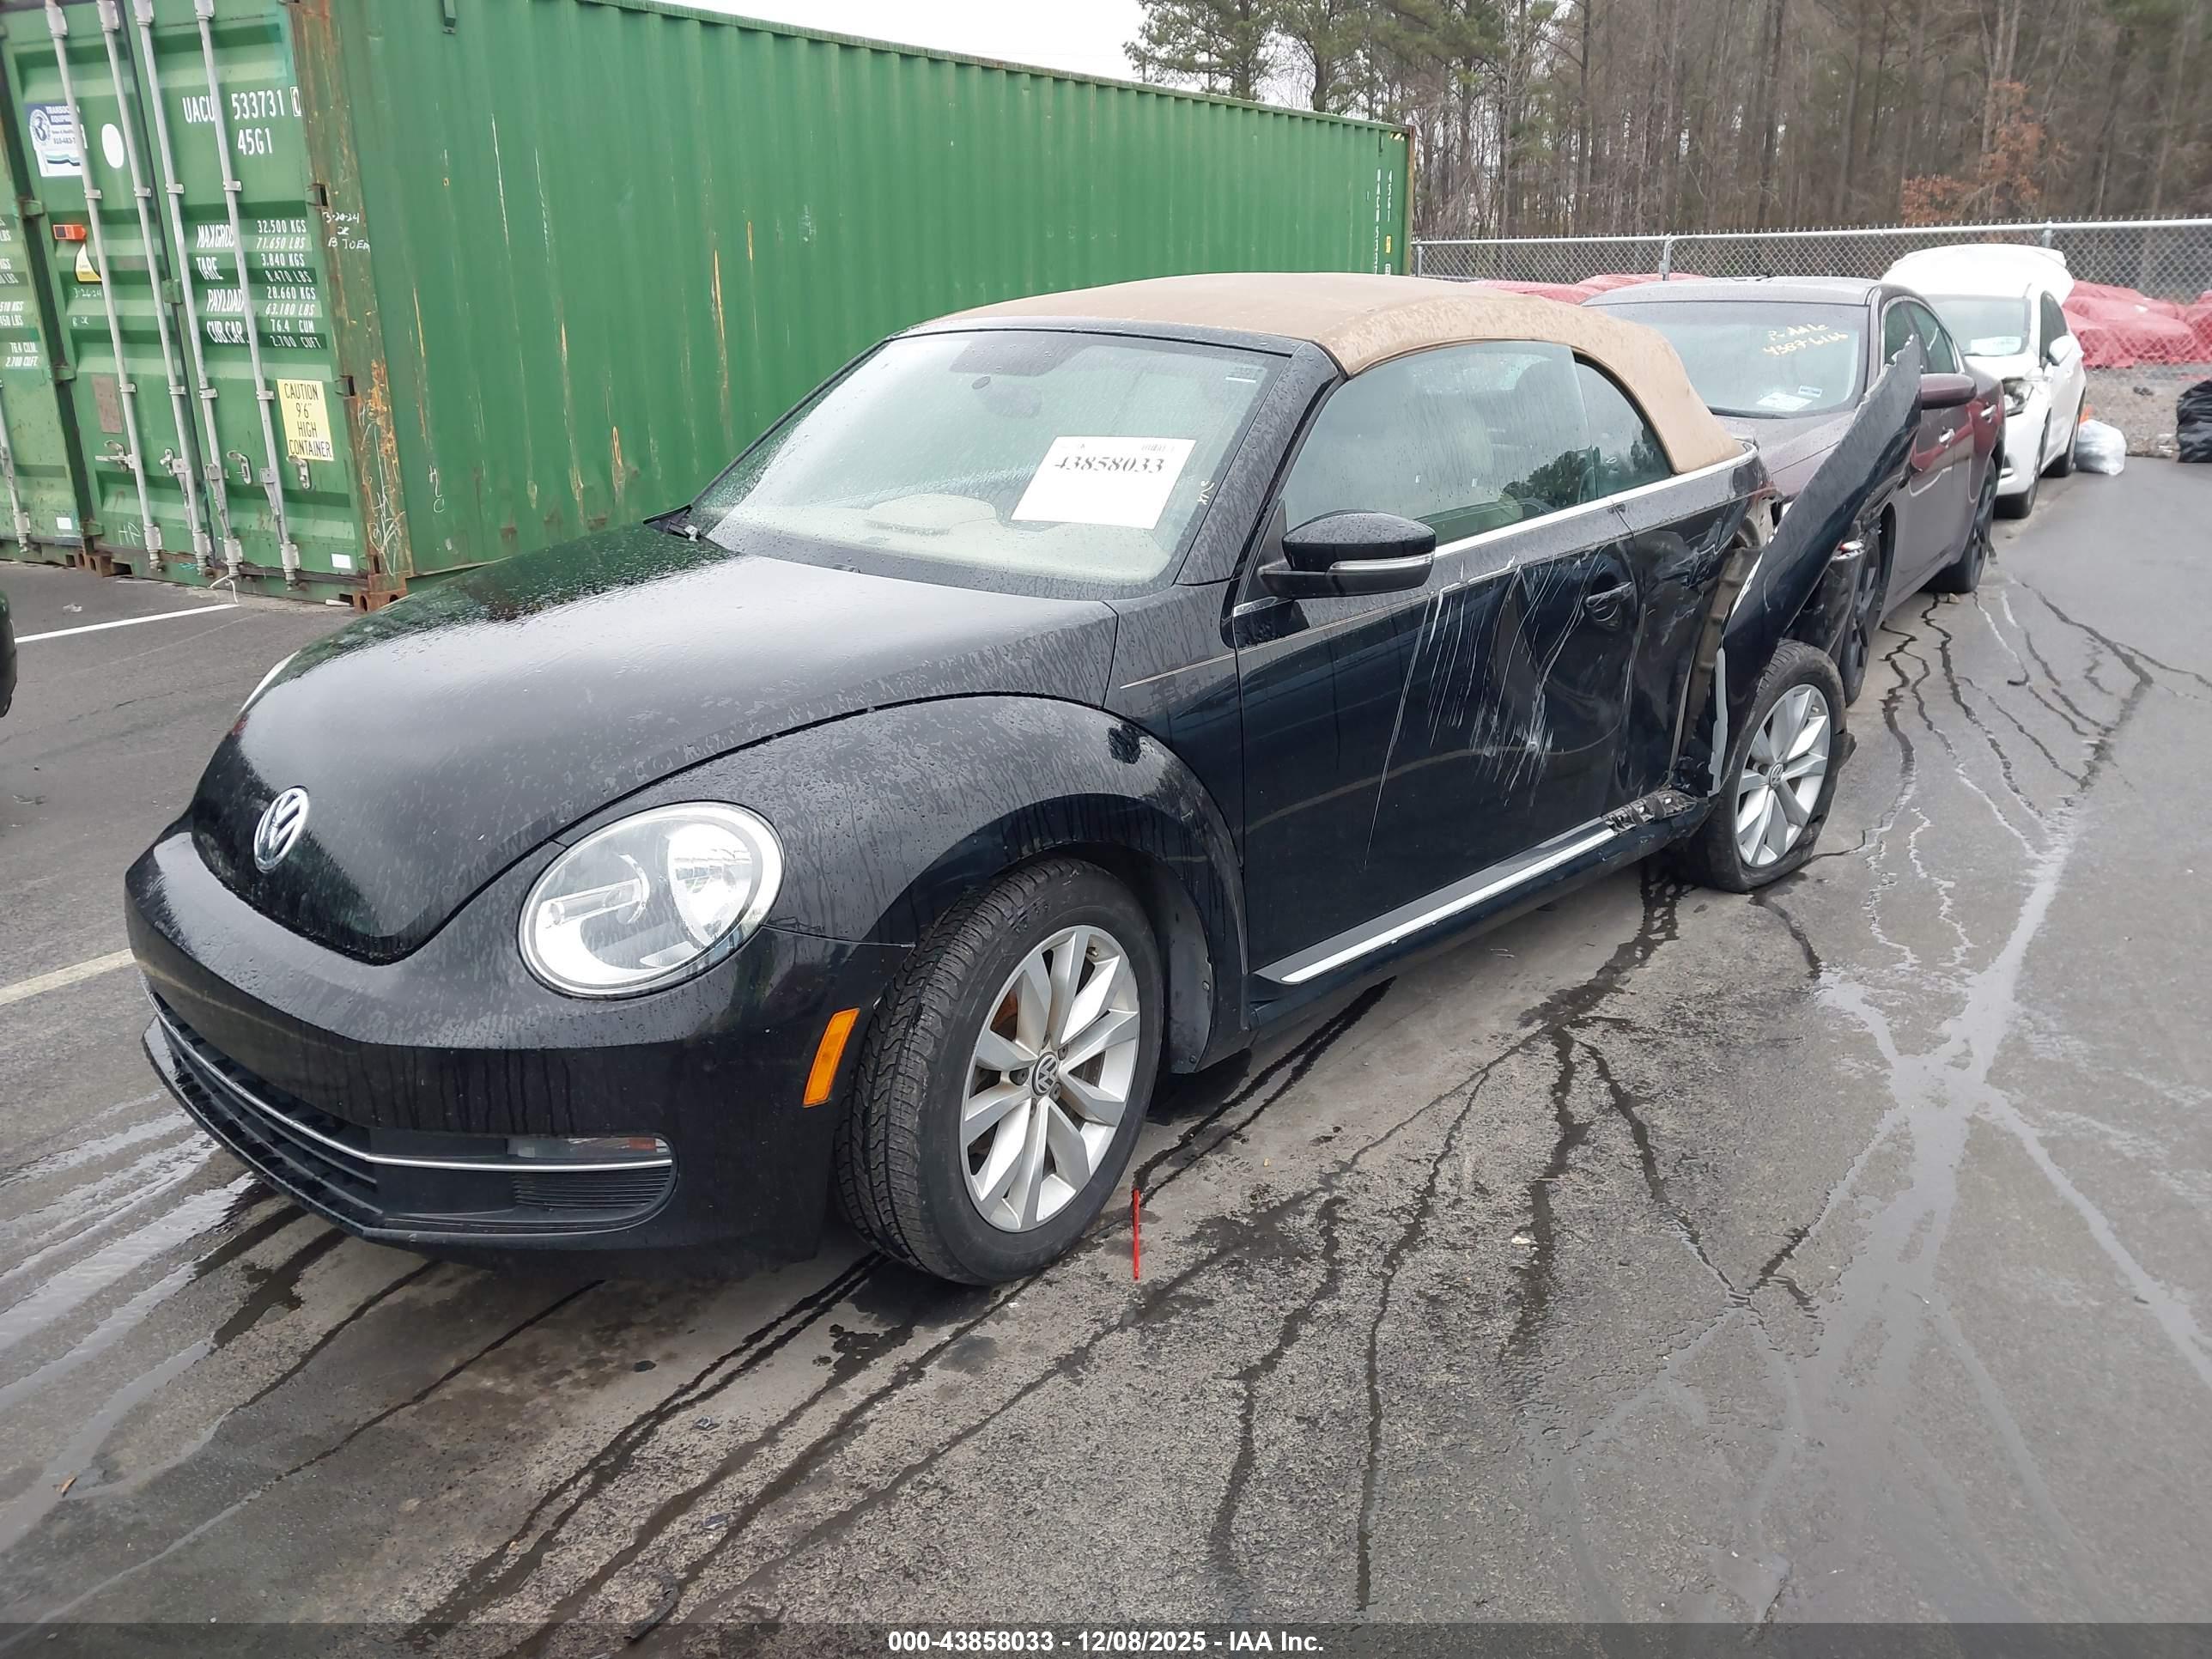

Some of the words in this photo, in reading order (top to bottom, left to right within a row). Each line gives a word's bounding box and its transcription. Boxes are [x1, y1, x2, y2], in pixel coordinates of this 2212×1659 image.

[231, 88, 285, 120] 533731
[238, 127, 273, 155] 45G1
[258, 220, 287, 234] 32.500
[291, 219, 307, 234] KGS
[256, 237, 285, 250] 71.650
[289, 237, 306, 250] LBS
[196, 257, 224, 280] TARE
[261, 253, 286, 267] 3.840
[289, 253, 306, 267] KGS
[265, 270, 293, 283] 8.470
[293, 270, 313, 283] LBS
[266, 286, 296, 300] 28.660
[300, 286, 316, 300] KGS
[265, 303, 295, 315] 63.180
[298, 303, 315, 316] LBS
[270, 319, 290, 332] 76.4
[298, 319, 315, 333] CUM
[269, 336, 297, 348] 2.700
[300, 337, 321, 349] CUFT
[283, 383, 319, 401] CAUTION
[296, 420, 318, 438] HIGH
[289, 439, 332, 458] CONTAINER
[1054, 456, 1164, 473] 43858033
